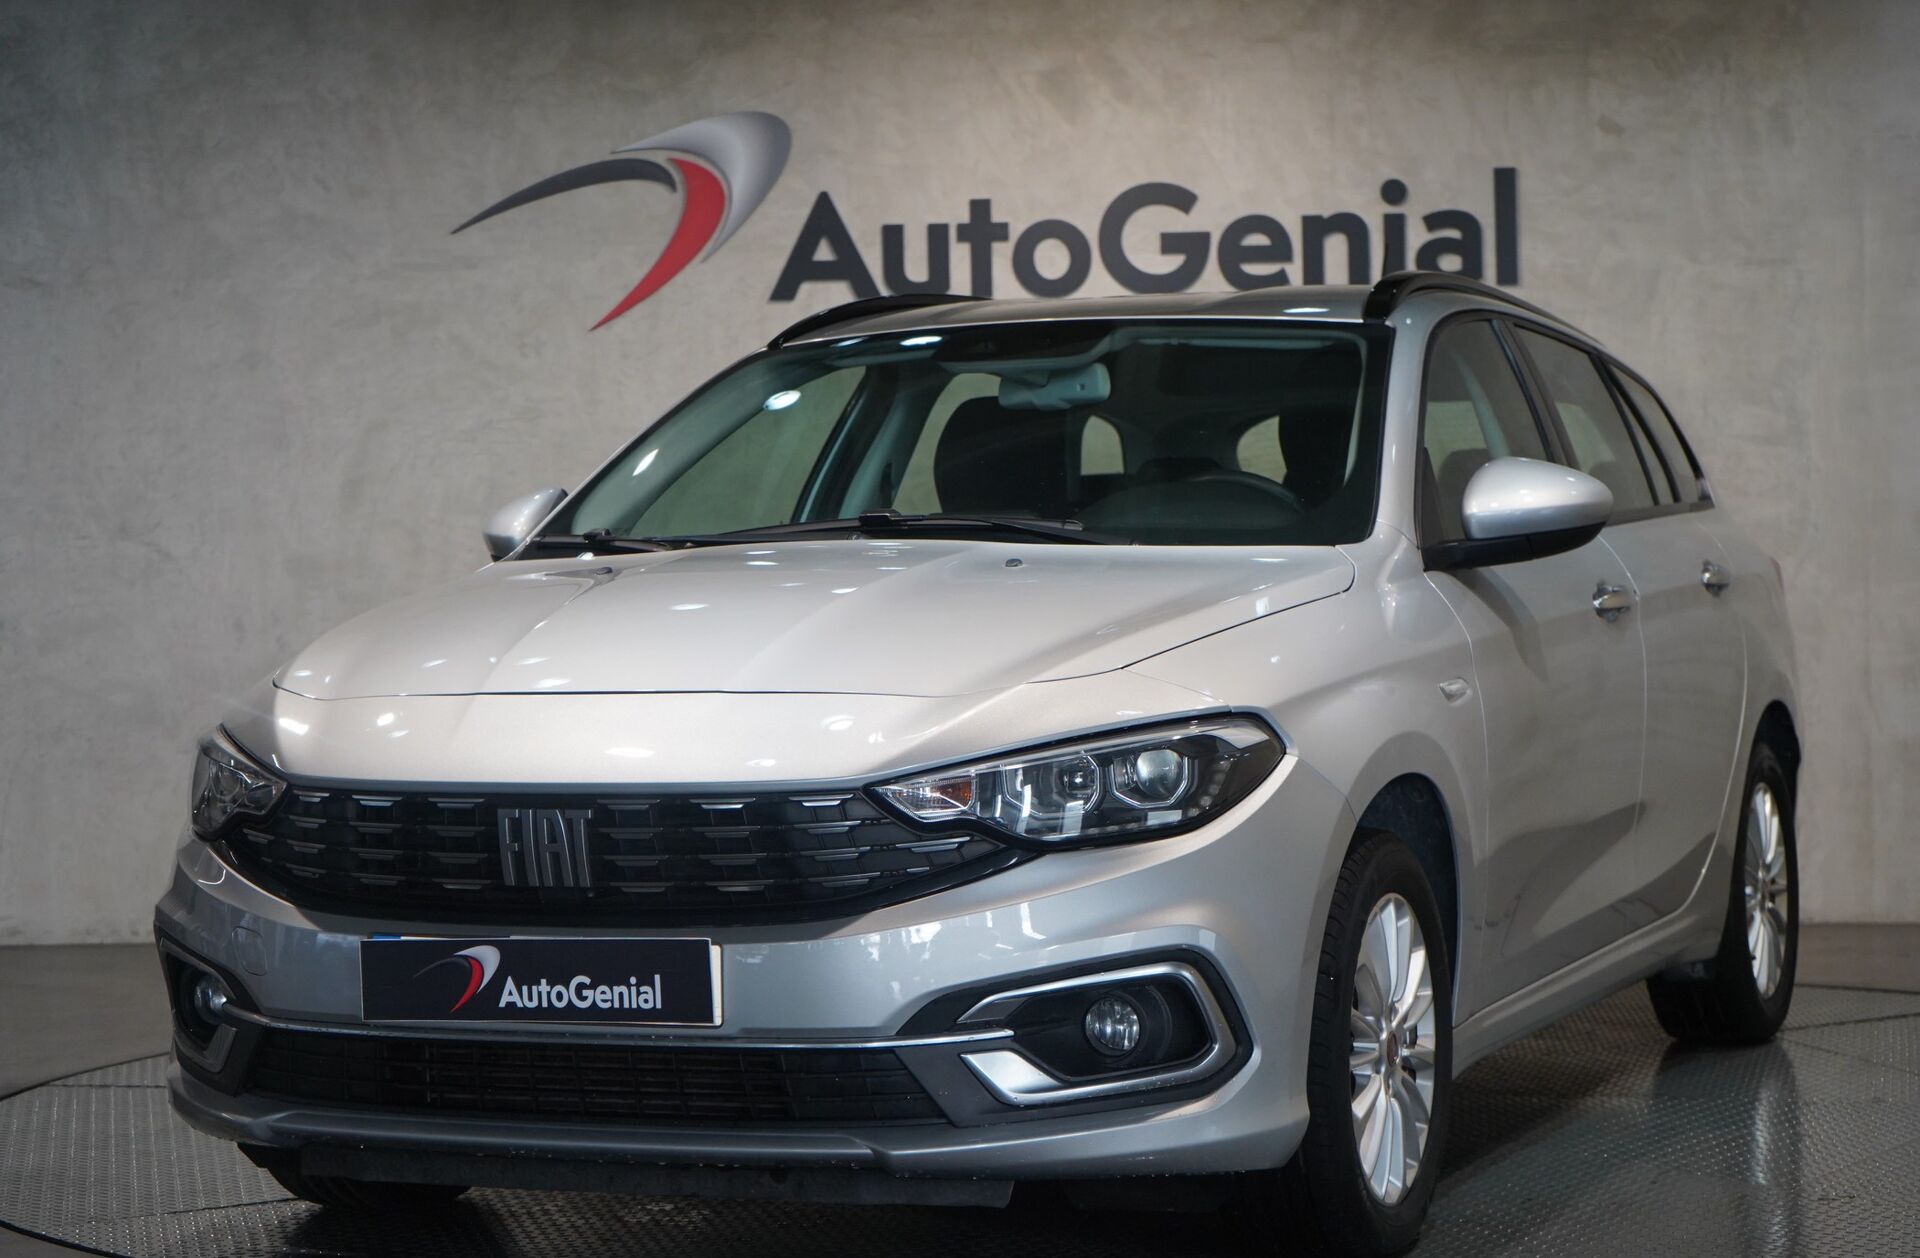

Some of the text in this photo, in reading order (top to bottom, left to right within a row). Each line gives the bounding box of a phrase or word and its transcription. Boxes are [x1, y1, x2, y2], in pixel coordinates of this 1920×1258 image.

[769, 167, 1519, 302] AutoGenial
[497, 808, 593, 888] FIAT
[499, 974, 662, 1009] AutoGenial
